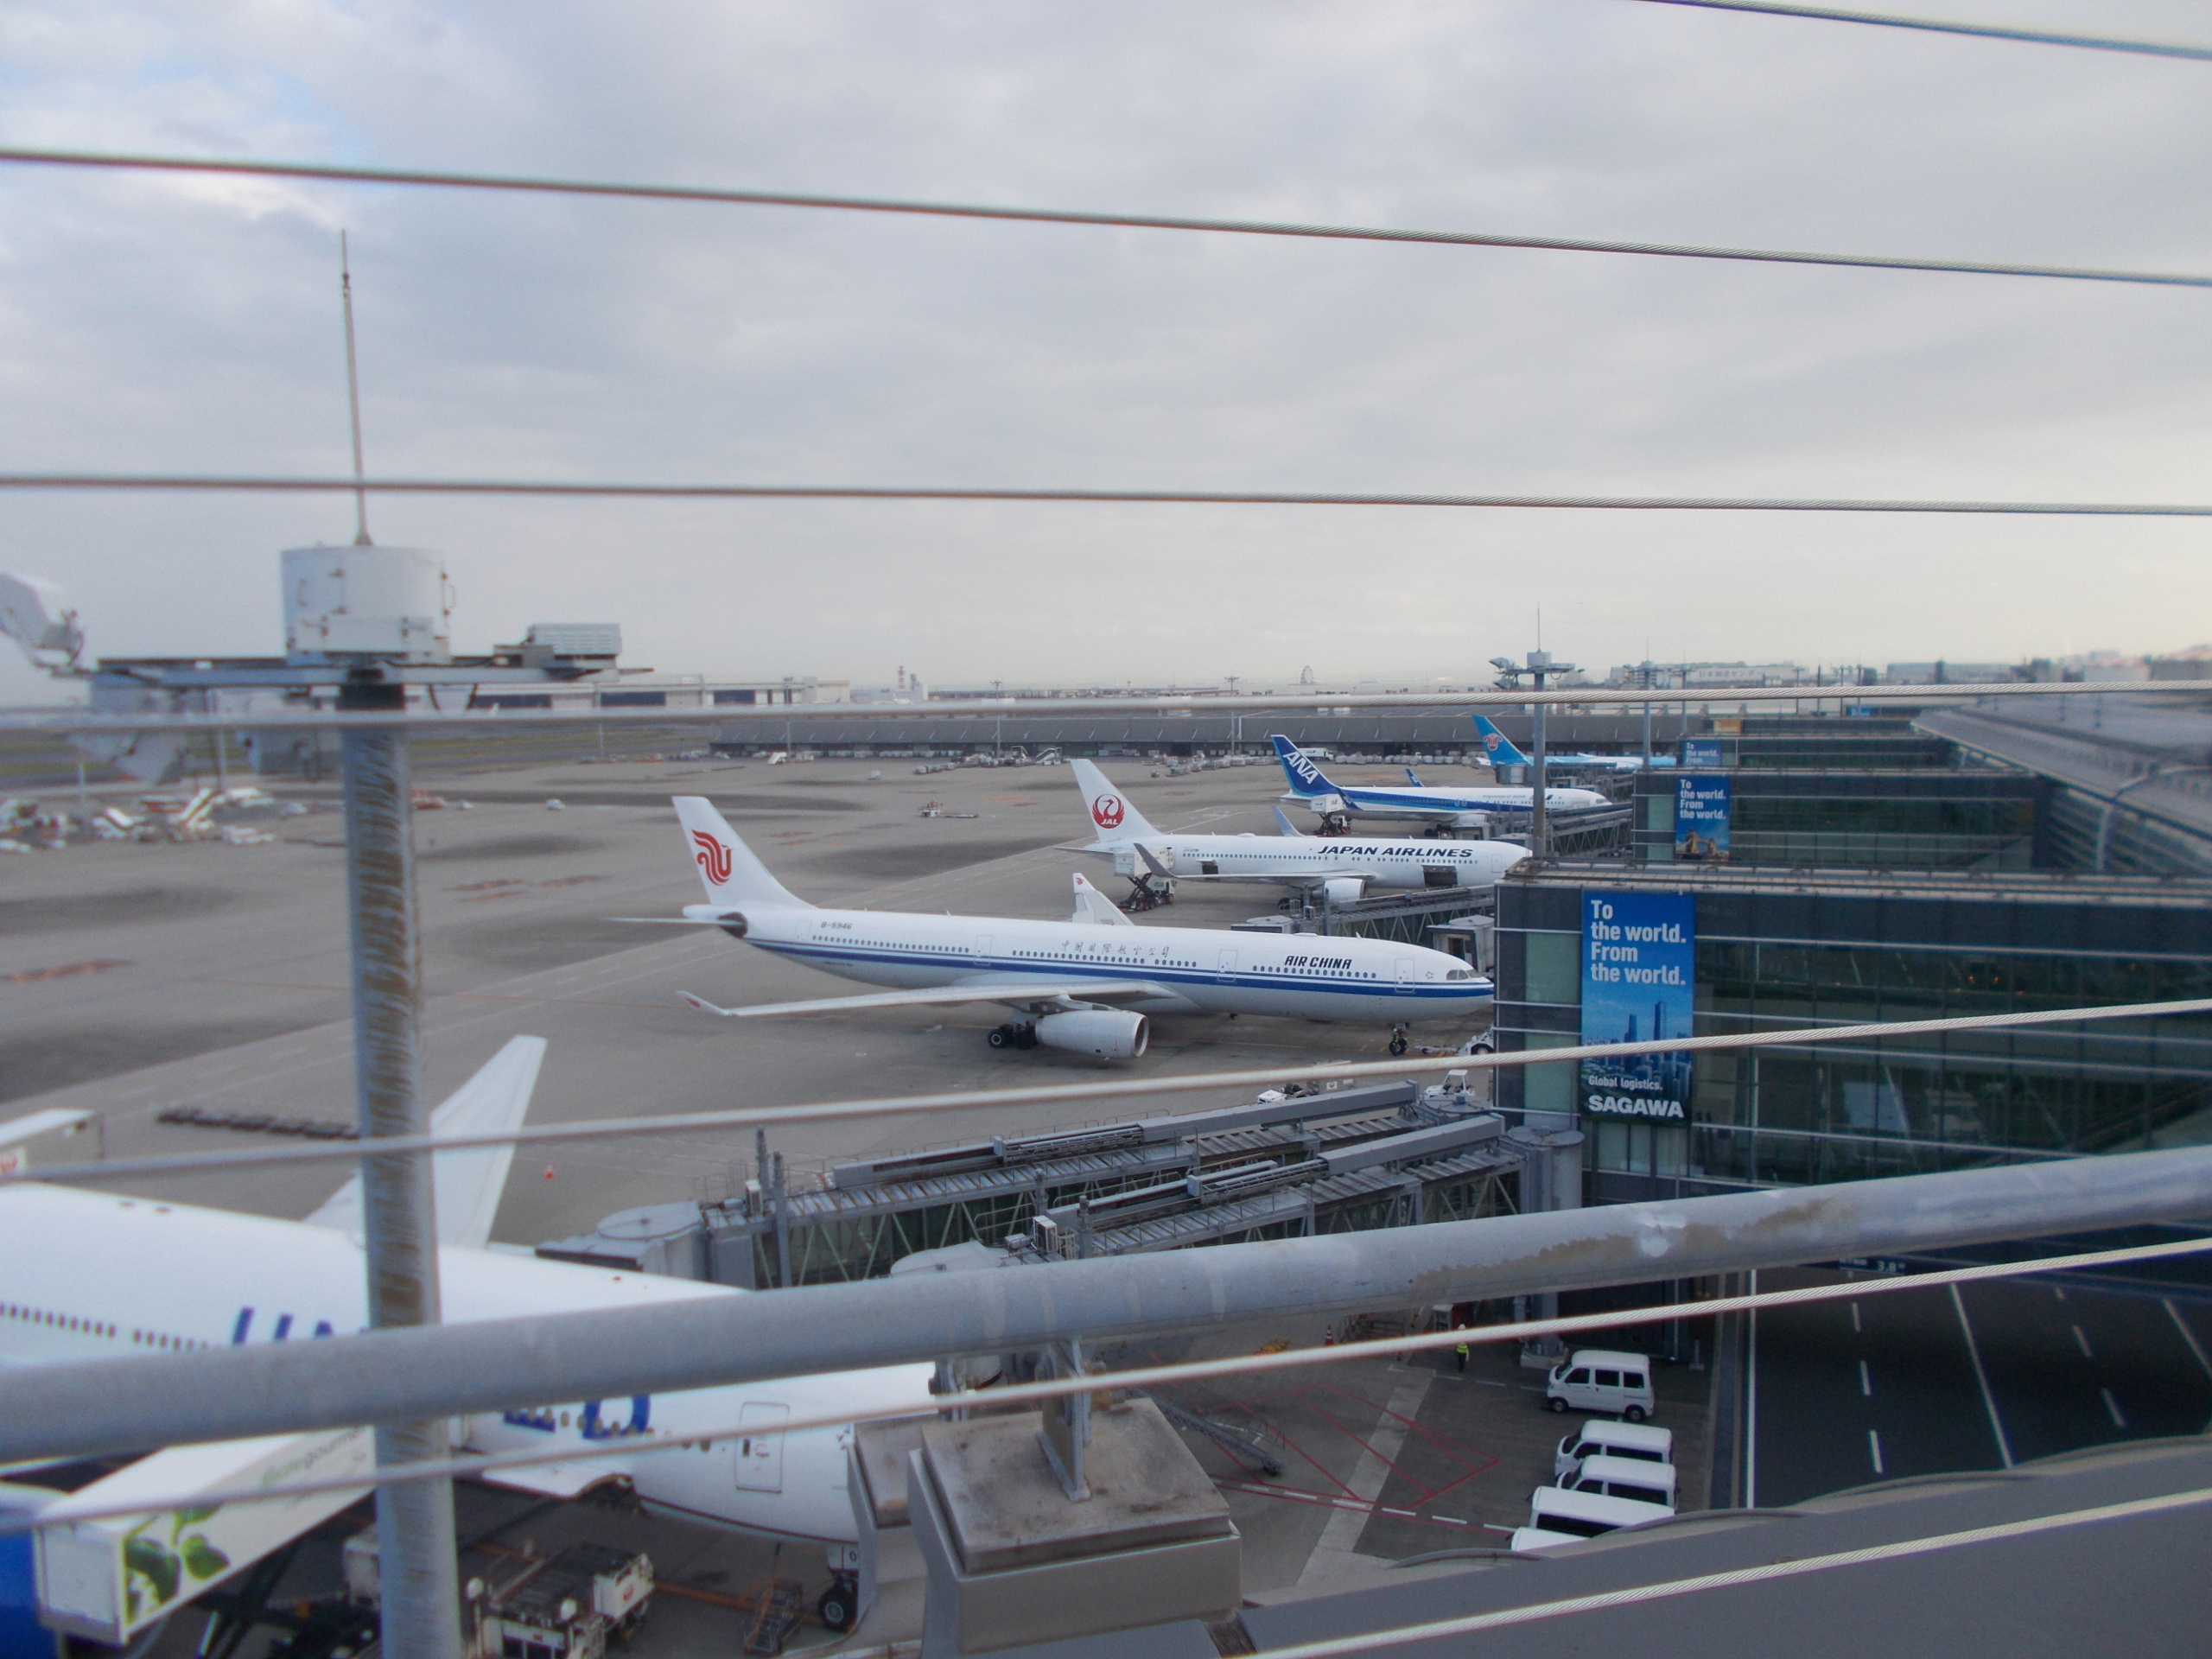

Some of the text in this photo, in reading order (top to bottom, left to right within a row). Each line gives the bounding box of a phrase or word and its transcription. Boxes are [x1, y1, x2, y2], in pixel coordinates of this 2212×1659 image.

[1282, 751, 1319, 785] ANA
[1680, 779, 1692, 789] To
[1680, 789, 1726, 799] the world.
[1680, 799, 1704, 810] From
[1680, 809, 1726, 819] the world.
[1318, 846, 1473, 858] JAPAN AIRLINES
[1591, 899, 1613, 920] To
[821, 921, 854, 930] B-5946
[1591, 921, 1687, 944] the world.
[1591, 941, 1638, 963] From
[1284, 955, 1352, 969] AIR CHINA
[1590, 963, 1686, 986] the world.
[1588, 1075, 1663, 1090] Global logistics.
[1588, 1094, 1685, 1118] SAGAWA
